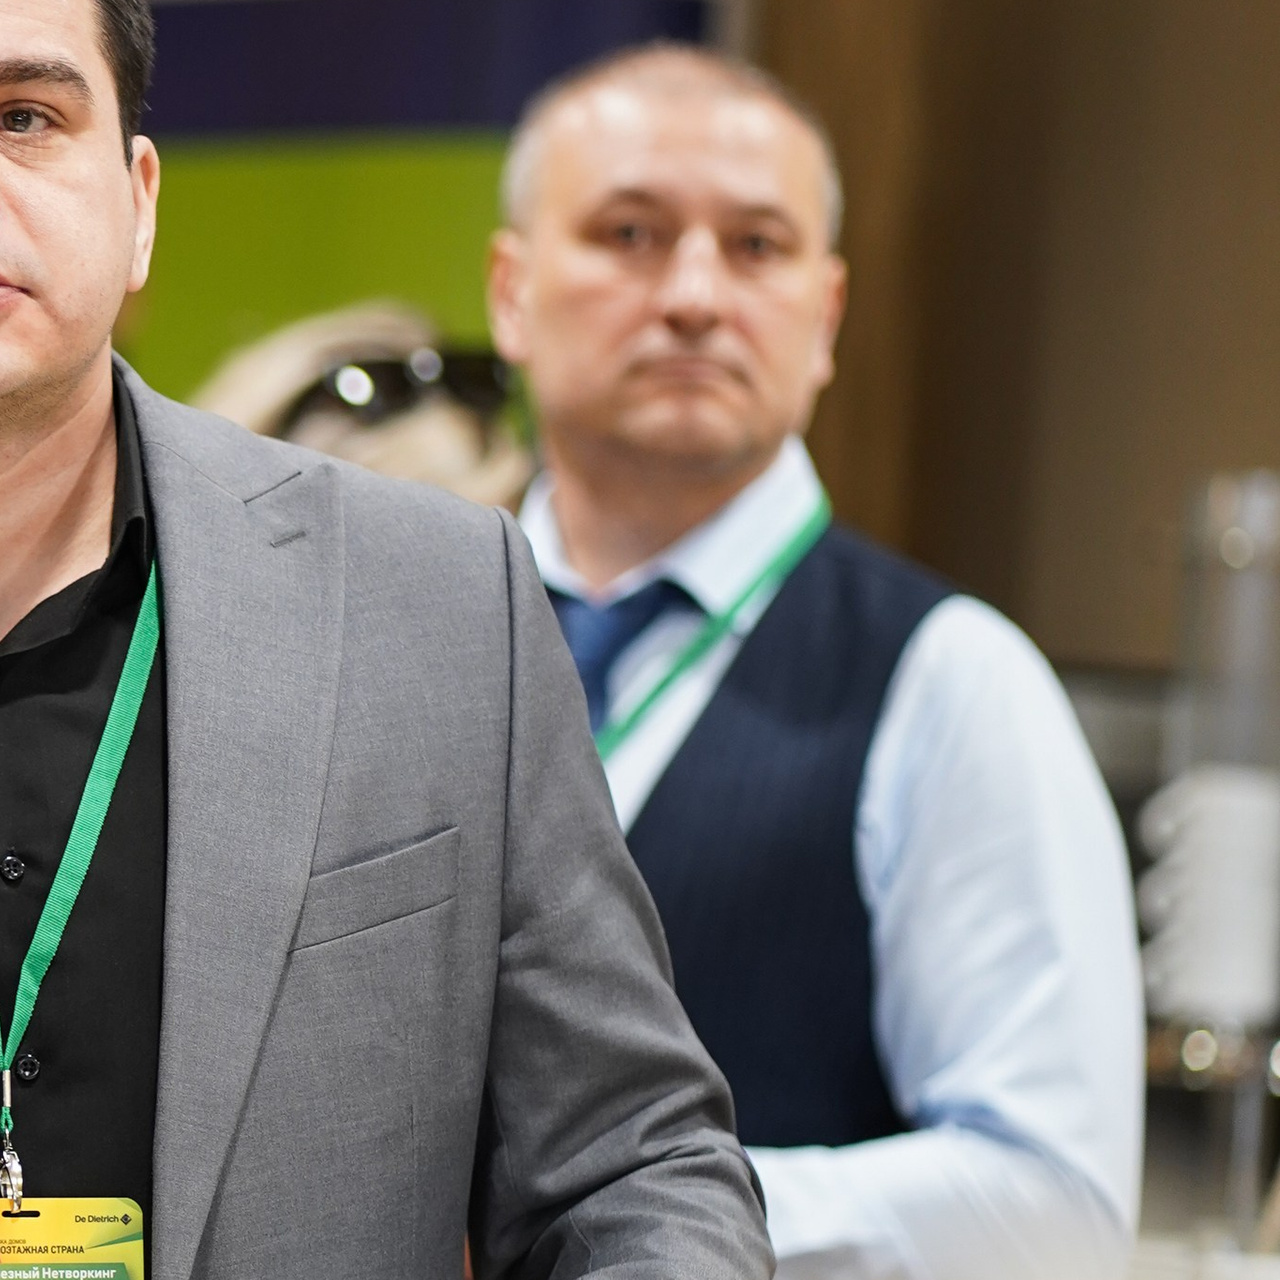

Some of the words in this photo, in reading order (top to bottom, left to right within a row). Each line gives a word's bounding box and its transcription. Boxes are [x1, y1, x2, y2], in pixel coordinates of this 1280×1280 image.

[75, 1215, 86, 1223] De
[88, 1215, 119, 1223] Dietrich
[51, 1246, 85, 1254] СТРАНА
[42, 1267, 117, 1280] Нетворкинг
